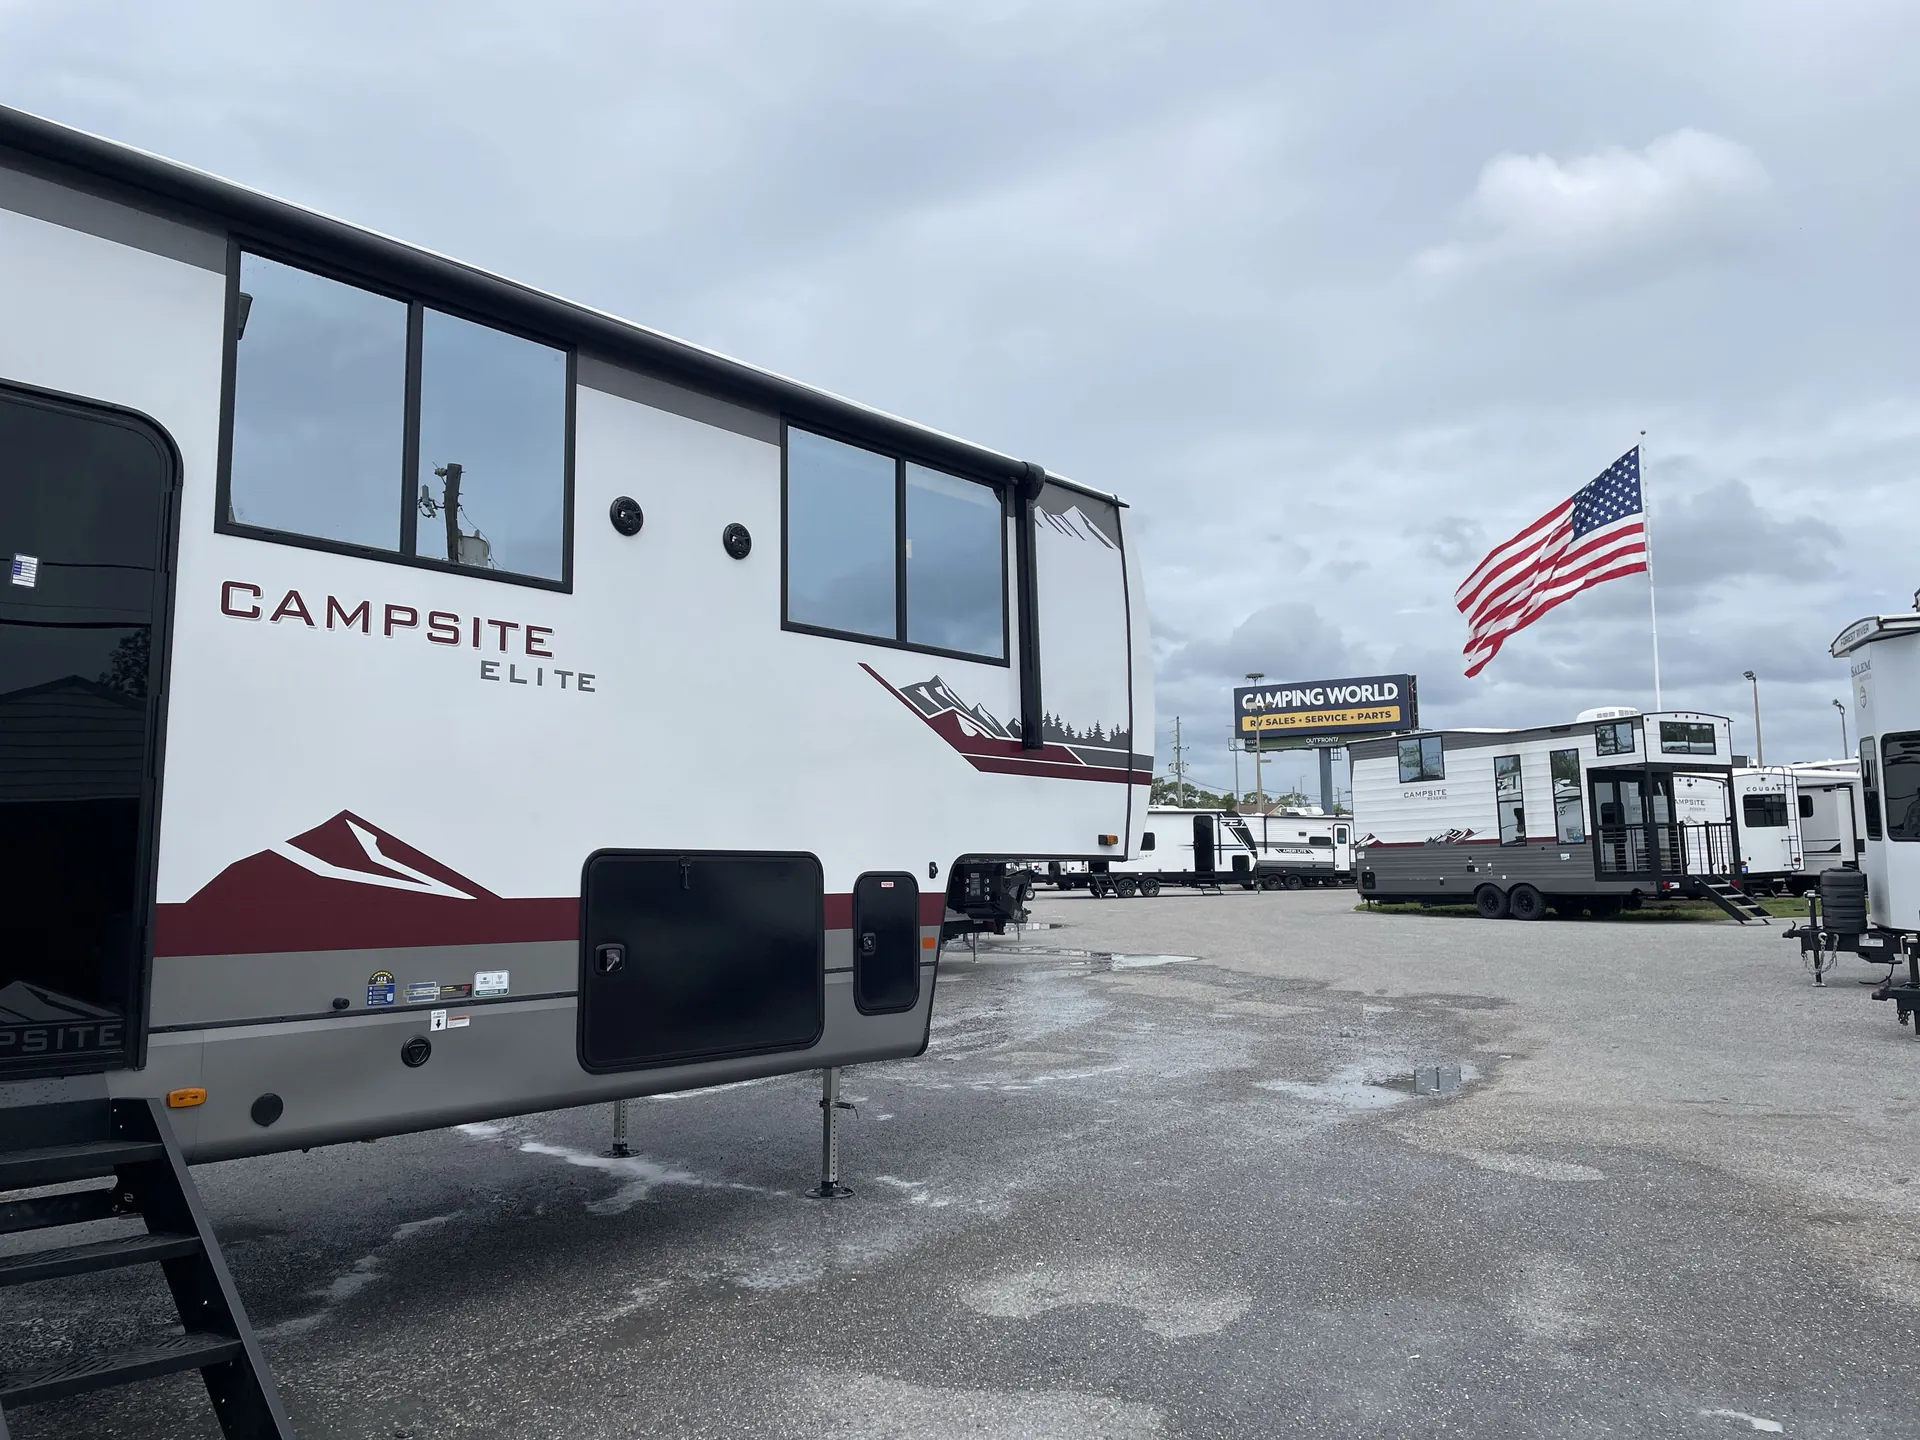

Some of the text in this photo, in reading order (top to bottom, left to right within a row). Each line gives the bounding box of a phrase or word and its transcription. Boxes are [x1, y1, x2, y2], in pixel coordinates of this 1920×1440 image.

[220, 579, 556, 659] CAMPSITE
[479, 659, 597, 693] ELITE
[1242, 682, 1399, 710] CAMPING WORLD
[1265, 716, 1297, 726] SALES
[1305, 713, 1348, 724] SERVICE
[1357, 710, 1392, 721] PARTS
[1403, 789, 1447, 798] CAMPSITE
[1675, 798, 1706, 806] AMPSITE
